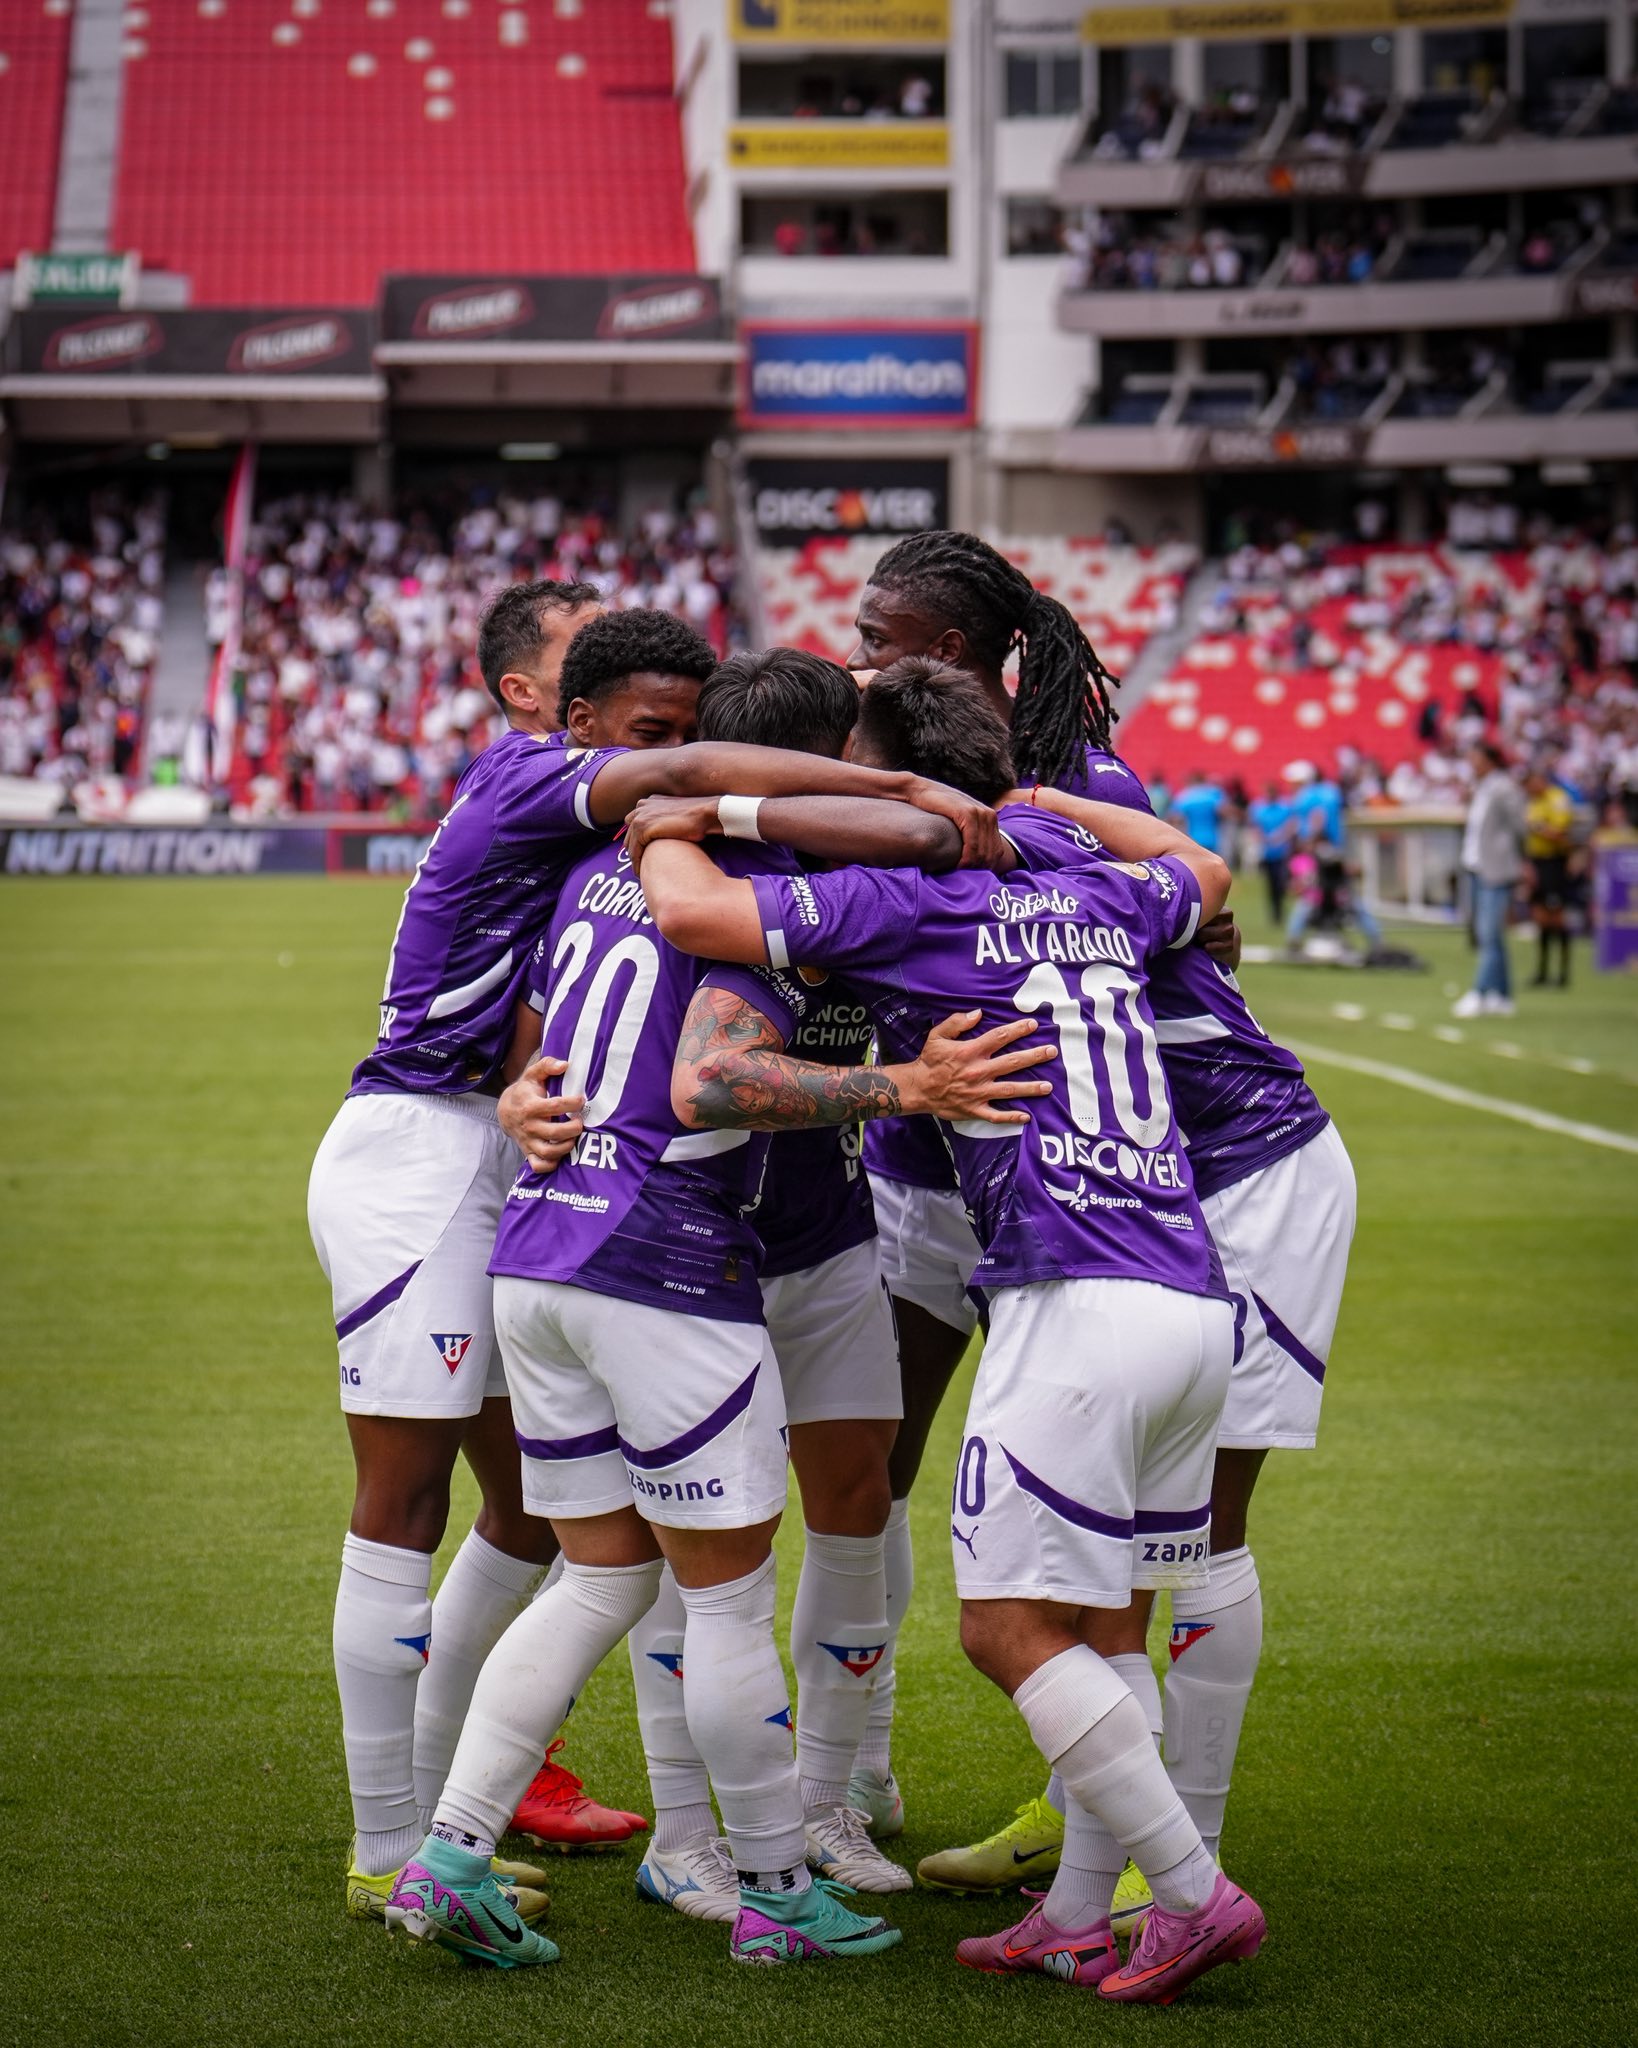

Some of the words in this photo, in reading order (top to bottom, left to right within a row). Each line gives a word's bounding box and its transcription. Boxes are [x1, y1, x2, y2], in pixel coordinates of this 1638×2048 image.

[753, 352, 966, 399] marathon
[756, 486, 934, 531] DISCOVER
[5, 831, 265, 875] NUTRITION
[976, 922, 1136, 966] ALVARADO
[541, 920, 660, 1128] 20
[1013, 961, 1170, 1149] 10
[1040, 1131, 1187, 1189] DISCOVER
[1089, 1193, 1143, 1209] Seguros
